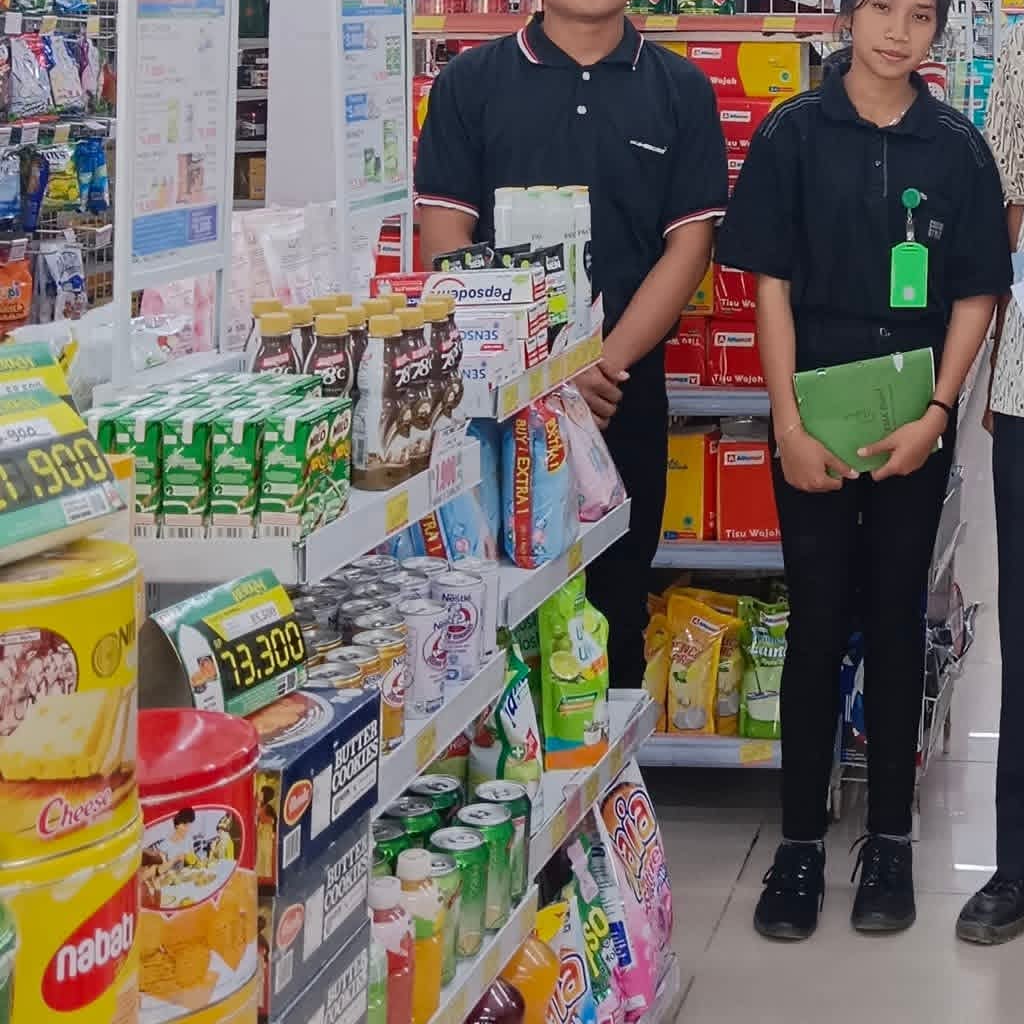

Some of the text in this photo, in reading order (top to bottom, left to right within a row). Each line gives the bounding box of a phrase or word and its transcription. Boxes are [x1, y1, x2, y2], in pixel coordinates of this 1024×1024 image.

[720, 298, 740, 308] Tisu
[515, 419, 528, 442] BUY
[516, 457, 531, 506] EXTRA
[726, 529, 747, 539] Tisu
[333, 737, 379, 793] COOKIES
[335, 719, 379, 770] BUTTER
[37, 787, 113, 838] Cheese
[55, 911, 134, 982] nabati
